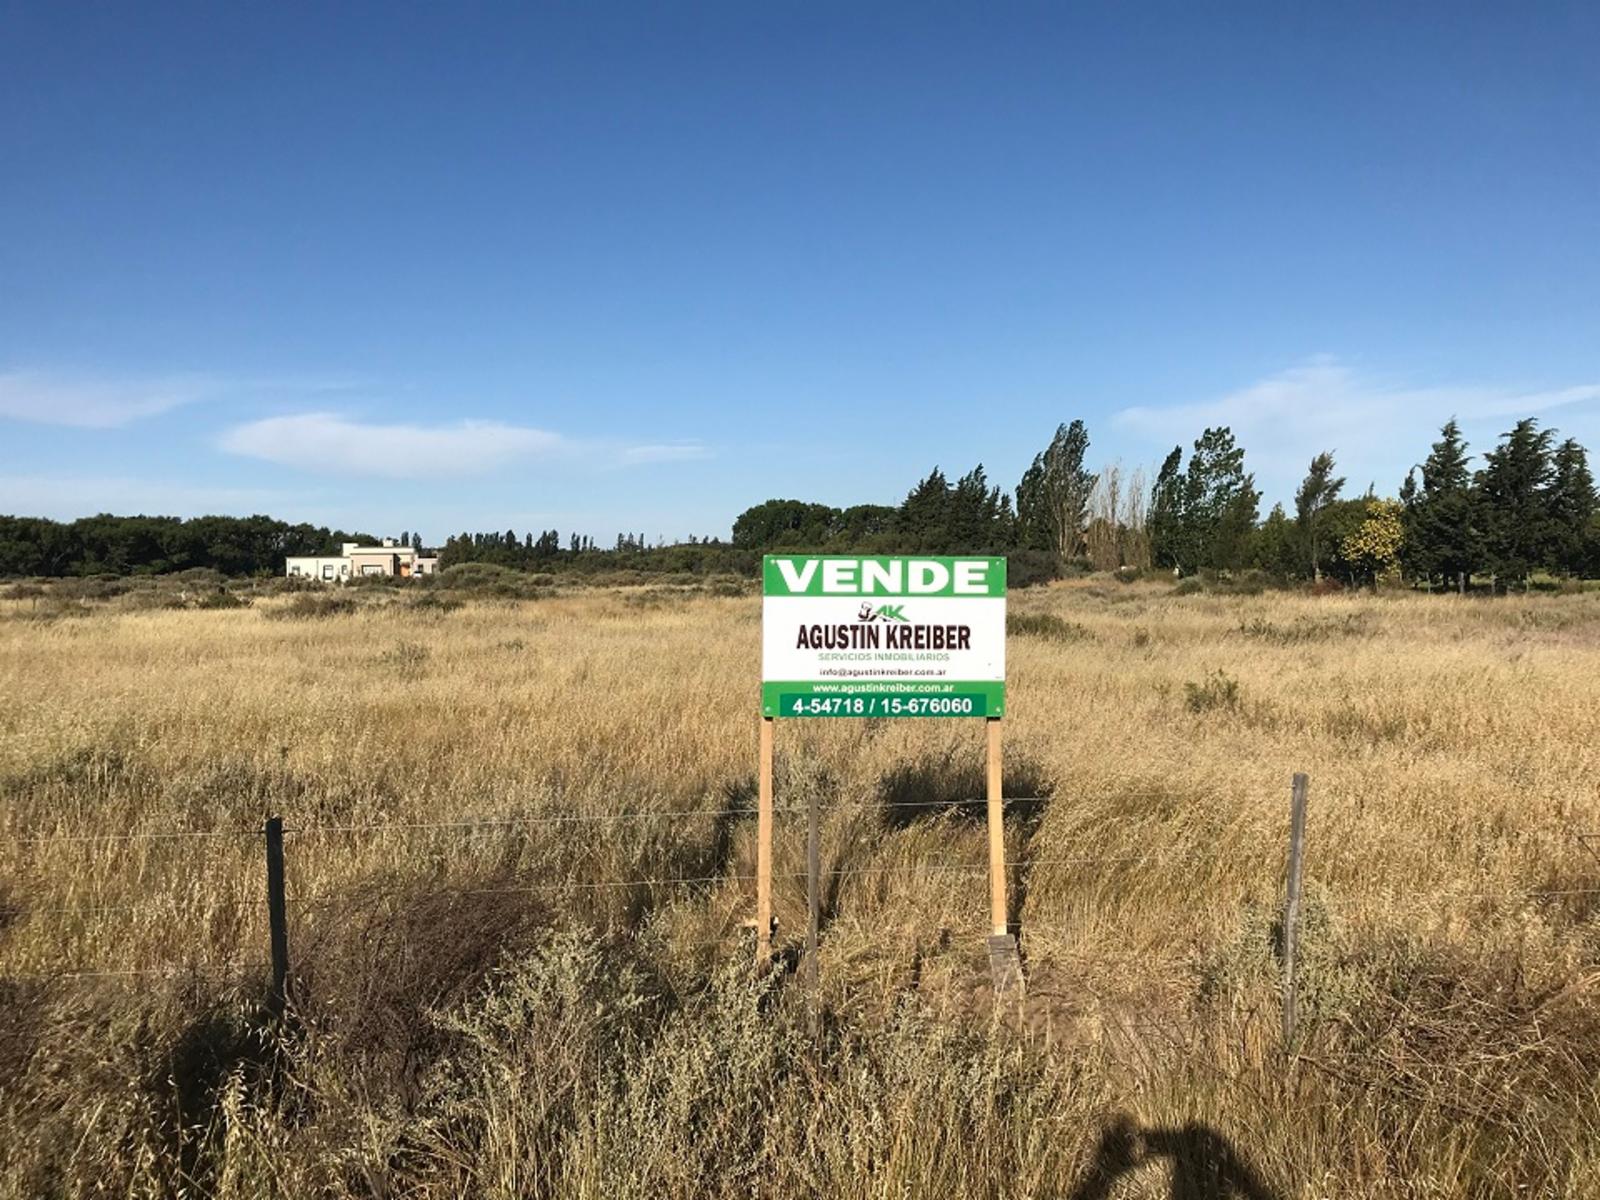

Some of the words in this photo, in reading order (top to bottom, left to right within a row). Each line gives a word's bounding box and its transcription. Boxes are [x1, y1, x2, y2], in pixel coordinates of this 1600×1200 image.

[776, 559, 990, 594] VENDE
[797, 624, 880, 650] AGUSTIN
[886, 624, 971, 650] KREIBER
[818, 652, 873, 662] SERVICIOS
[874, 652, 950, 662] INMOBILIARIOS
[819, 667, 947, 678] info@agustinkreiber.com.ar
[813, 682, 955, 694] www.agustinkreiber.com.ar
[792, 698, 865, 714] 4-54718
[869, 698, 877, 713] /
[881, 698, 973, 714] 15-676060
